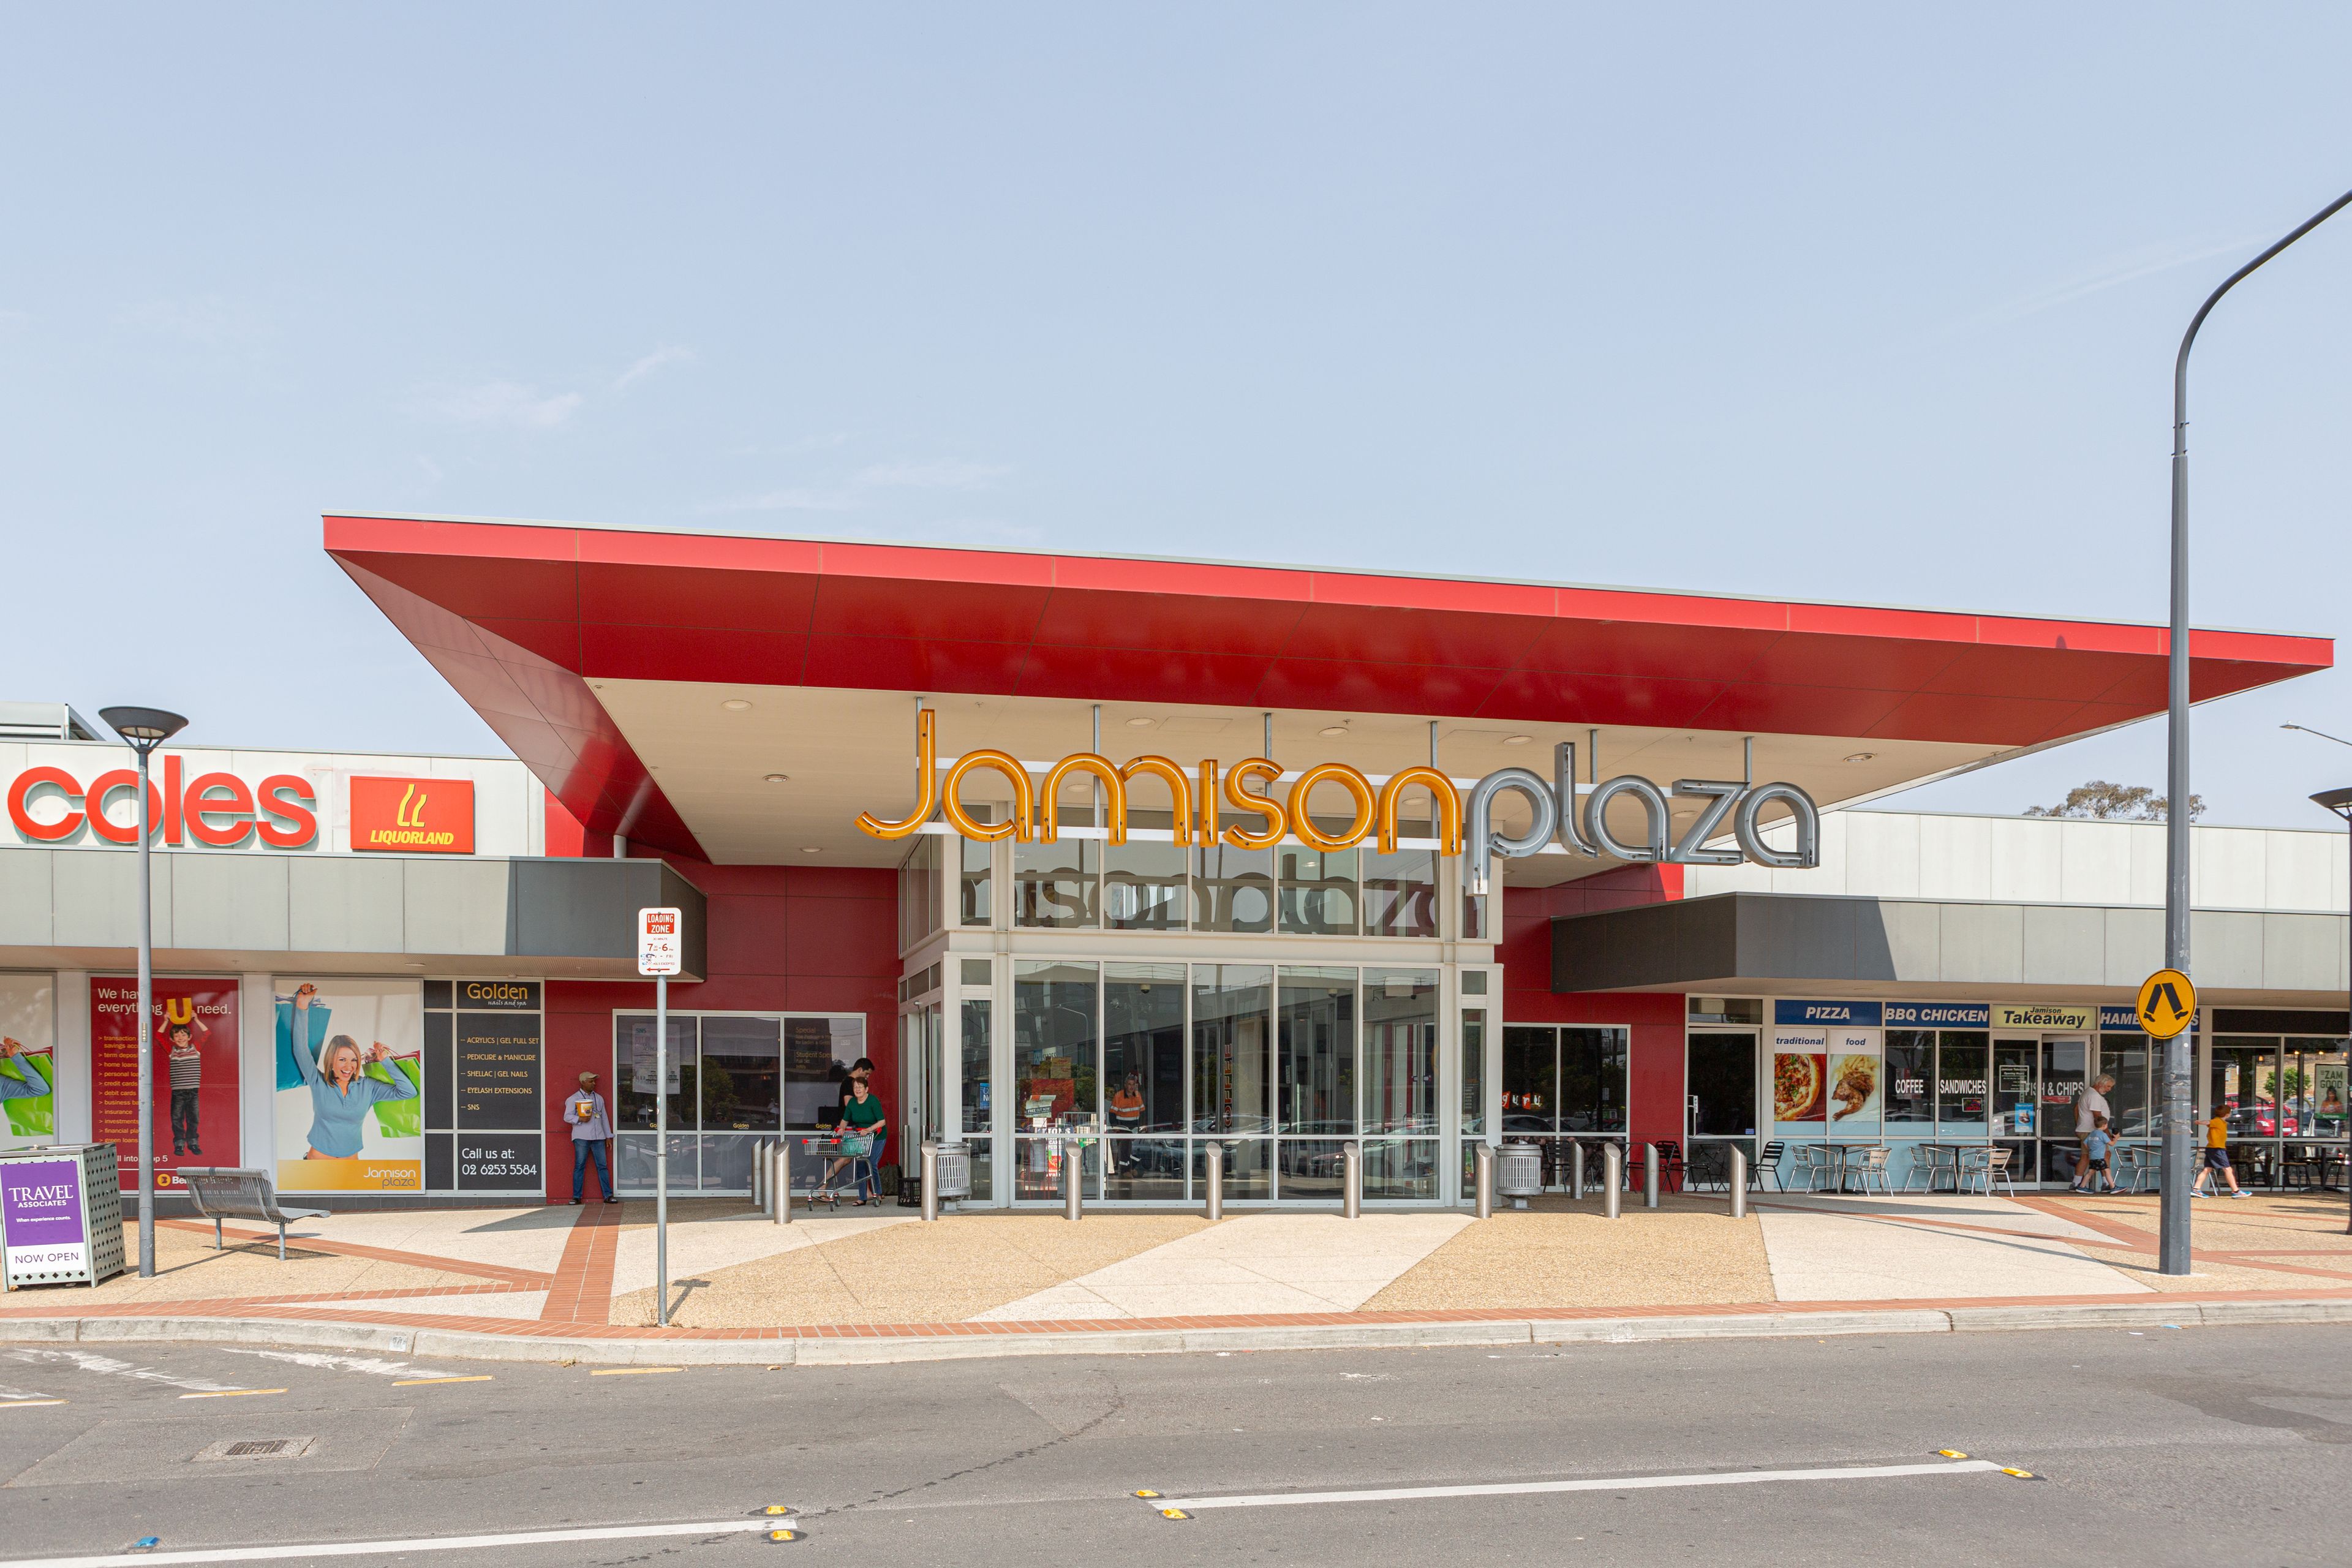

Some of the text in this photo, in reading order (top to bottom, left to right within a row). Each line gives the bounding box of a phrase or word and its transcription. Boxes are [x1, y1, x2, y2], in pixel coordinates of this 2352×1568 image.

[7, 755, 317, 847] coles
[370, 829, 454, 846] LIQUORLAND
[647, 914, 674, 923] LOADING
[651, 924, 670, 933] ZONE
[98, 988, 117, 999] We
[467, 983, 528, 1000] Golden
[167, 997, 193, 1025] U
[197, 1004, 232, 1014] need.
[1806, 1007, 1850, 1019] PIZZA
[1885, 1008, 1989, 1022] BBQ CHICKEN
[2003, 1010, 2086, 1028] Takeaway
[2324, 1070, 2343, 1080] ZAM
[1895, 1079, 1924, 1093] COFFEE
[1940, 1079, 1986, 1094] SANDWICHES
[2047, 1082, 2054, 1096] &
[2056, 1082, 2084, 1096] CHIPS
[2320, 1080, 2343, 1089] GOOD
[462, 1148, 515, 1159] Call us at:
[363, 1166, 416, 1178] Jamison
[462, 1164, 537, 1175] 02 6253 5584
[382, 1176, 415, 1189] plaza
[17, 1200, 67, 1208] ASSOCIATES
[15, 1252, 79, 1264] NOW OPEN
